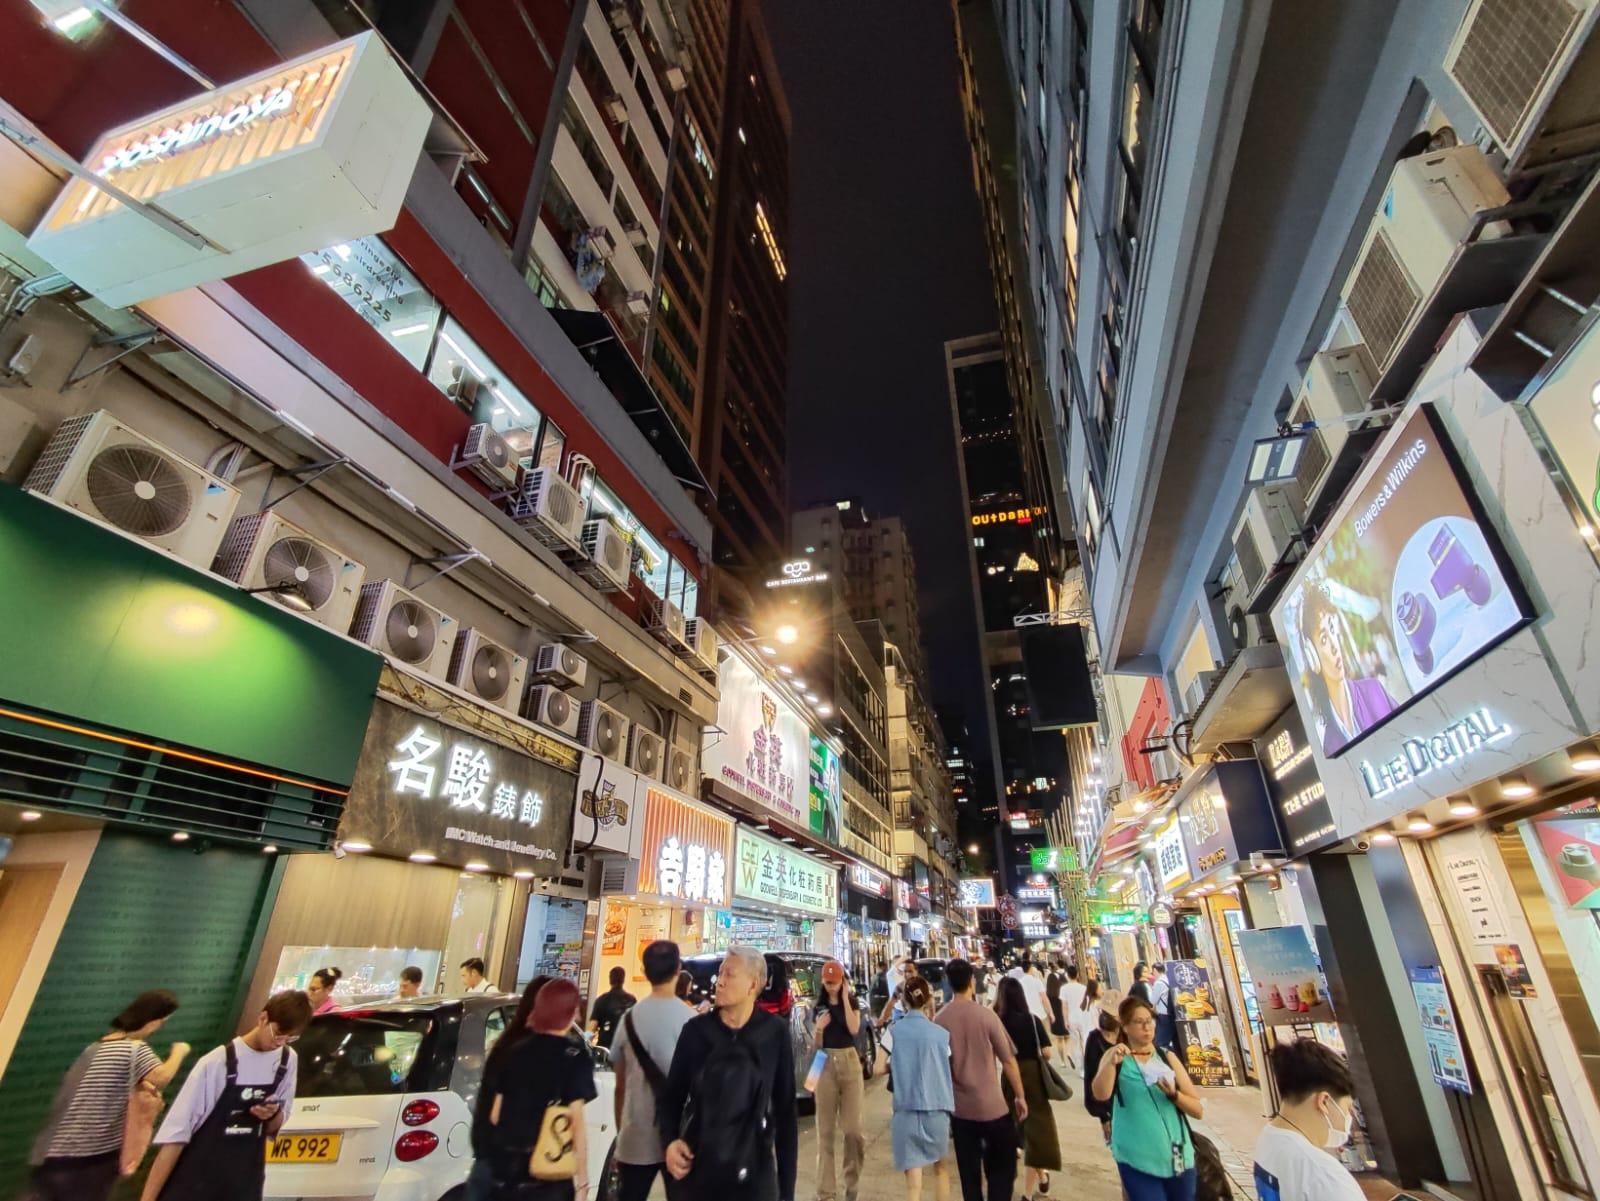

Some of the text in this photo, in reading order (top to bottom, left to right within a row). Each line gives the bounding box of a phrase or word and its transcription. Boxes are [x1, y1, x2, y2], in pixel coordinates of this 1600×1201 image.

[313, 249, 392, 323] 5686225
[1354, 493, 1387, 538] Bowers
[1387, 438, 1427, 491] Wilkins
[463, 830, 494, 848] Watch
[495, 839, 510, 850] and
[546, 849, 558, 860] Co.
[270, 1138, 331, 1159] WR 992
